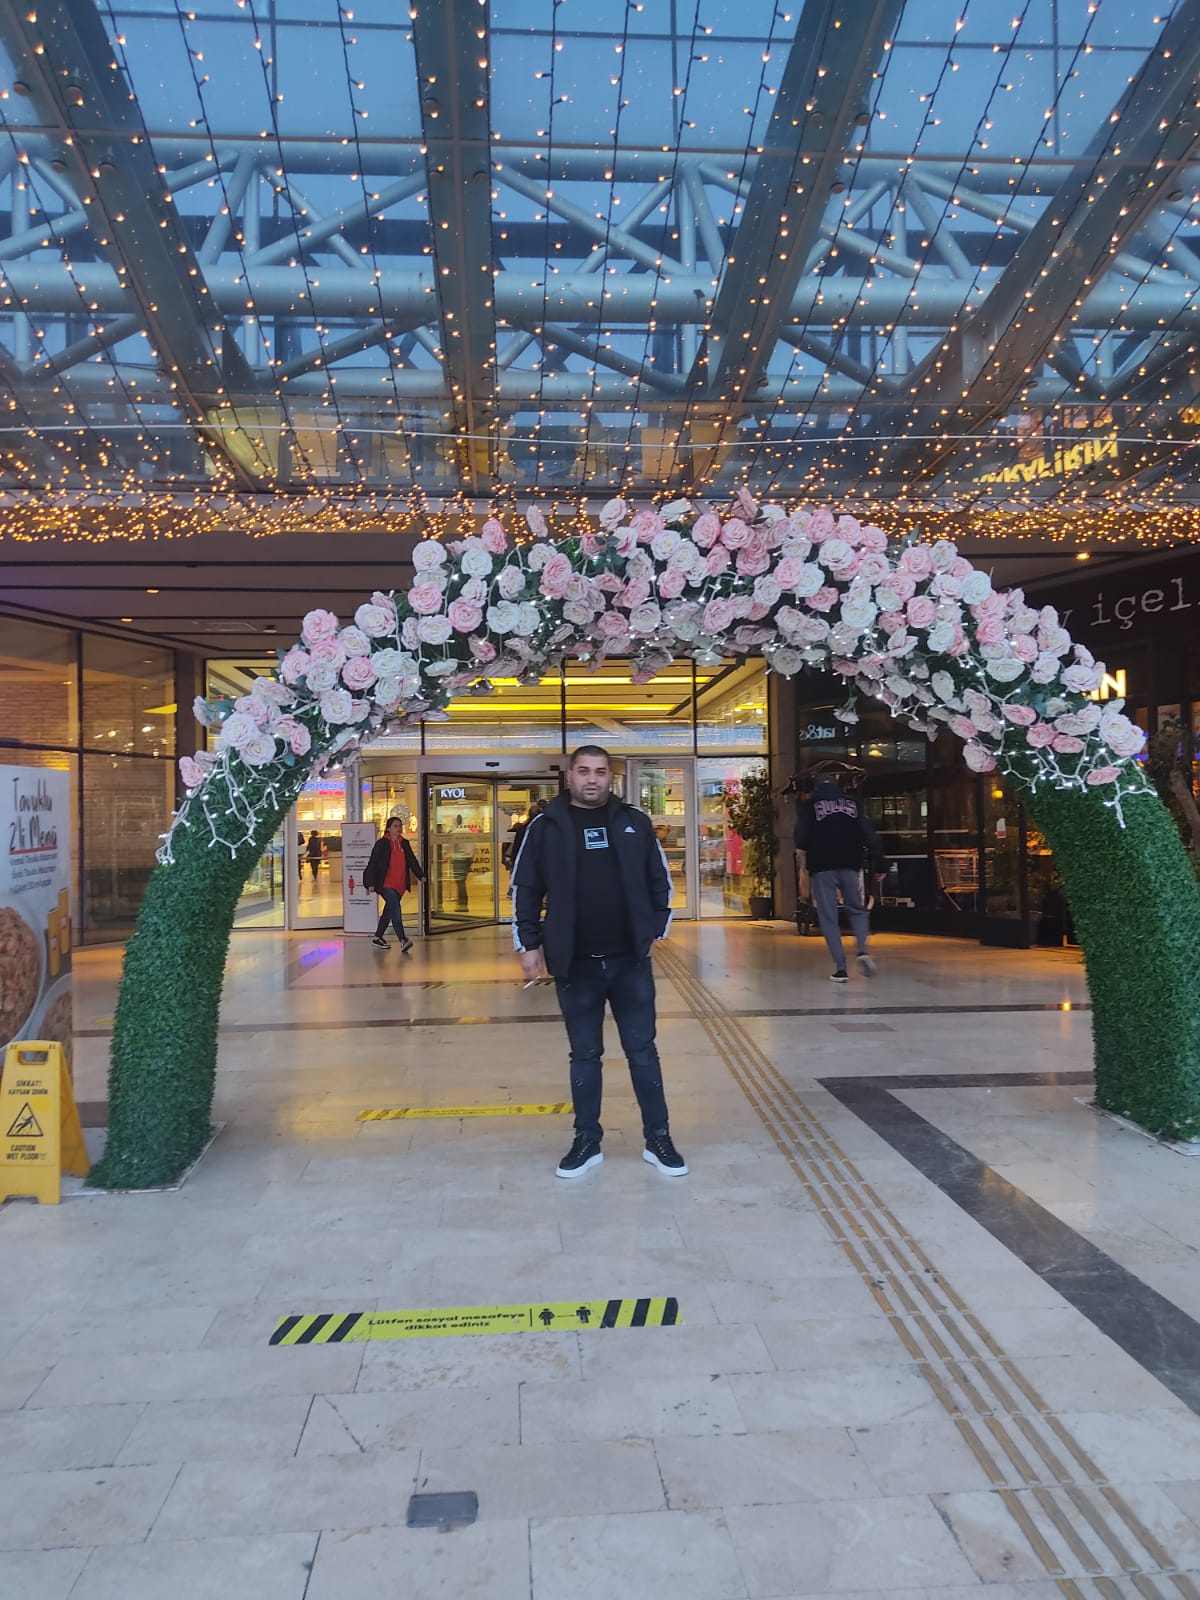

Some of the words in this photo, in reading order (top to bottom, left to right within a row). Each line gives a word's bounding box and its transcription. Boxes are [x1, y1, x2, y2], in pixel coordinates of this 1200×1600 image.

[1090, 577, 1200, 630] içel
[12, 777, 52, 812] Tavuklu
[815, 798, 858, 821] BULLS
[29, 814, 57, 848] Menü
[6, 1152, 18, 1160] WET
[10, 1144, 36, 1152] CAUTION
[368, 1318, 413, 1326] Lütfen
[416, 1315, 459, 1323] sosyal
[461, 1312, 525, 1321] mesafeye
[405, 1323, 448, 1331] dikkat
[450, 1320, 491, 1328] ediniz
